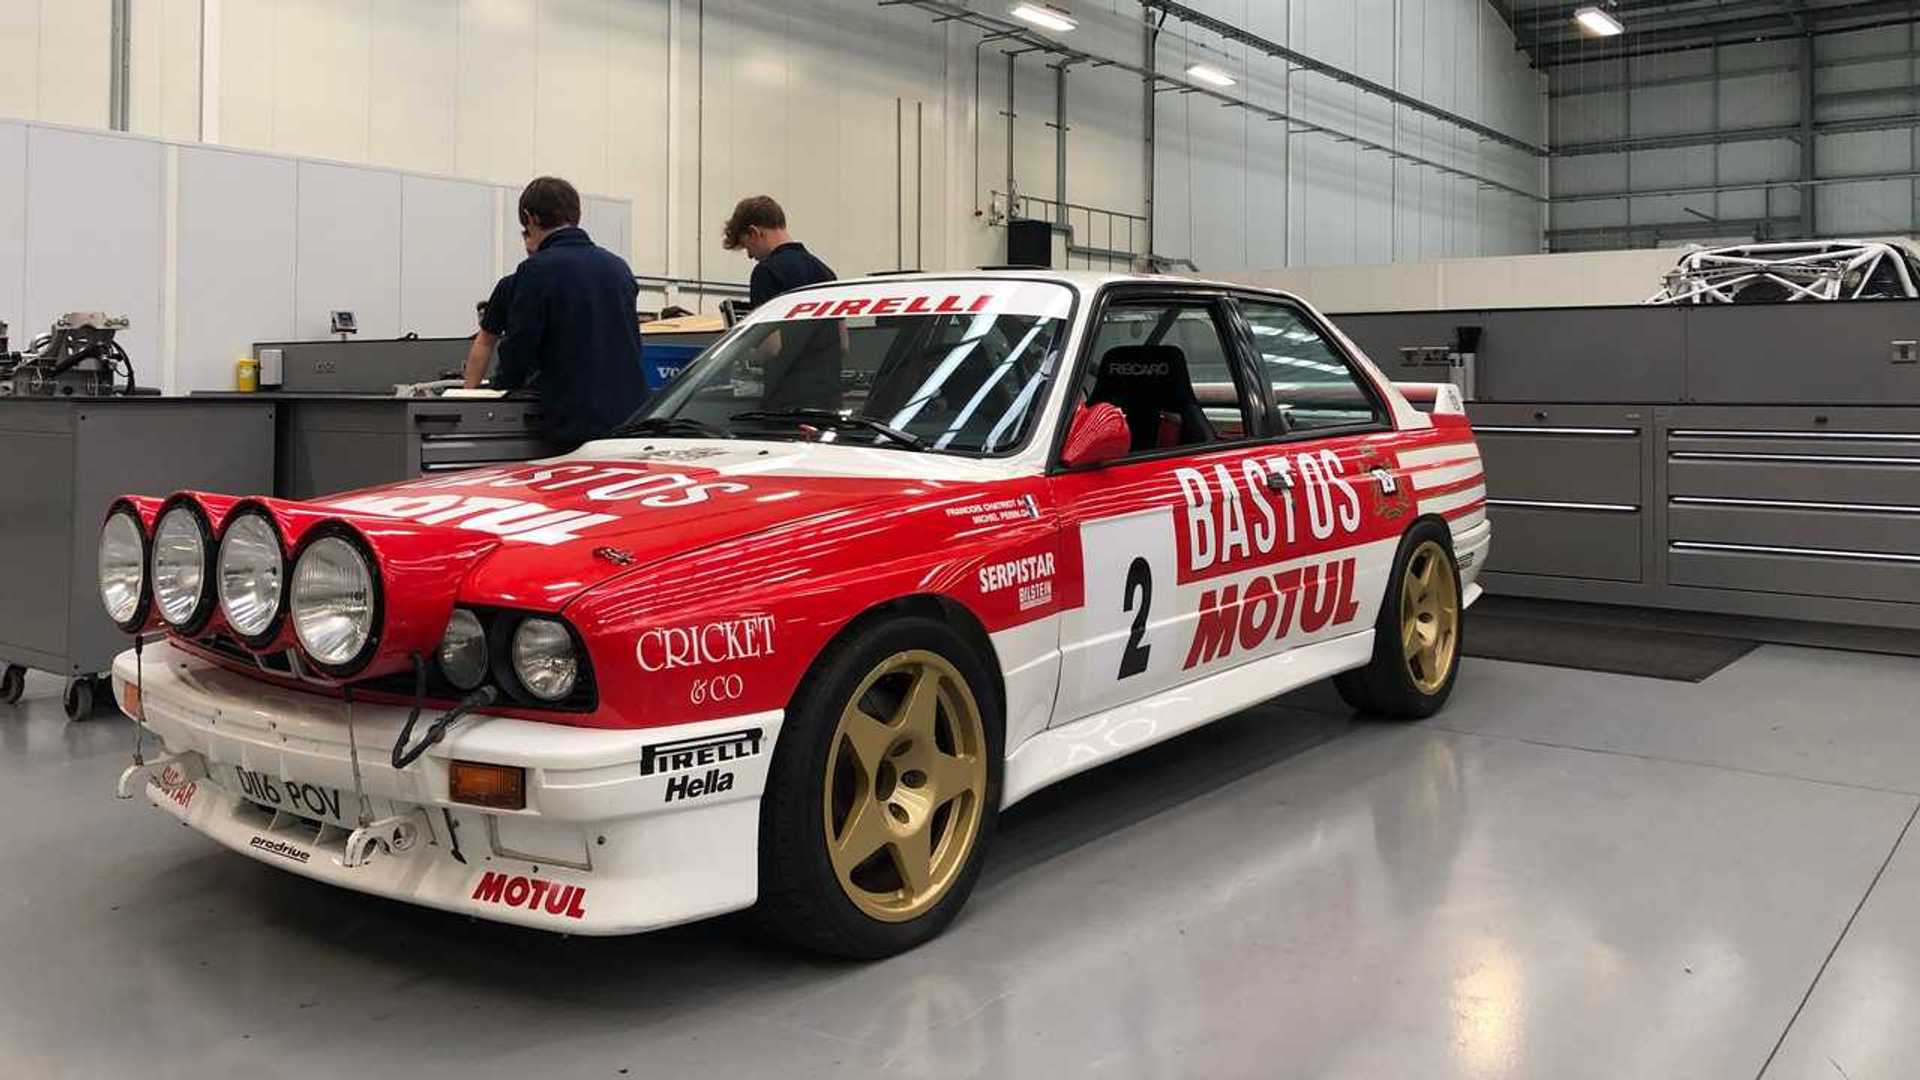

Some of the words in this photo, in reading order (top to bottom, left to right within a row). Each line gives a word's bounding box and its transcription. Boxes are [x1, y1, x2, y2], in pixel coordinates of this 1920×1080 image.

[784, 295, 994, 319] PIRELLI
[1109, 362, 1169, 376] RECARO
[1175, 449, 1361, 571] BASTOS
[979, 551, 1056, 594] SERPISTAR
[1117, 557, 1152, 681] 2
[1182, 557, 1360, 671] MOTUL
[636, 614, 776, 672] CRICKET
[640, 727, 764, 776] PIRELLI
[236, 765, 282, 804] D116
[285, 781, 341, 820] POV
[664, 769, 734, 802] Hella
[250, 834, 311, 863] prodrive
[472, 871, 586, 919] MOTUL
